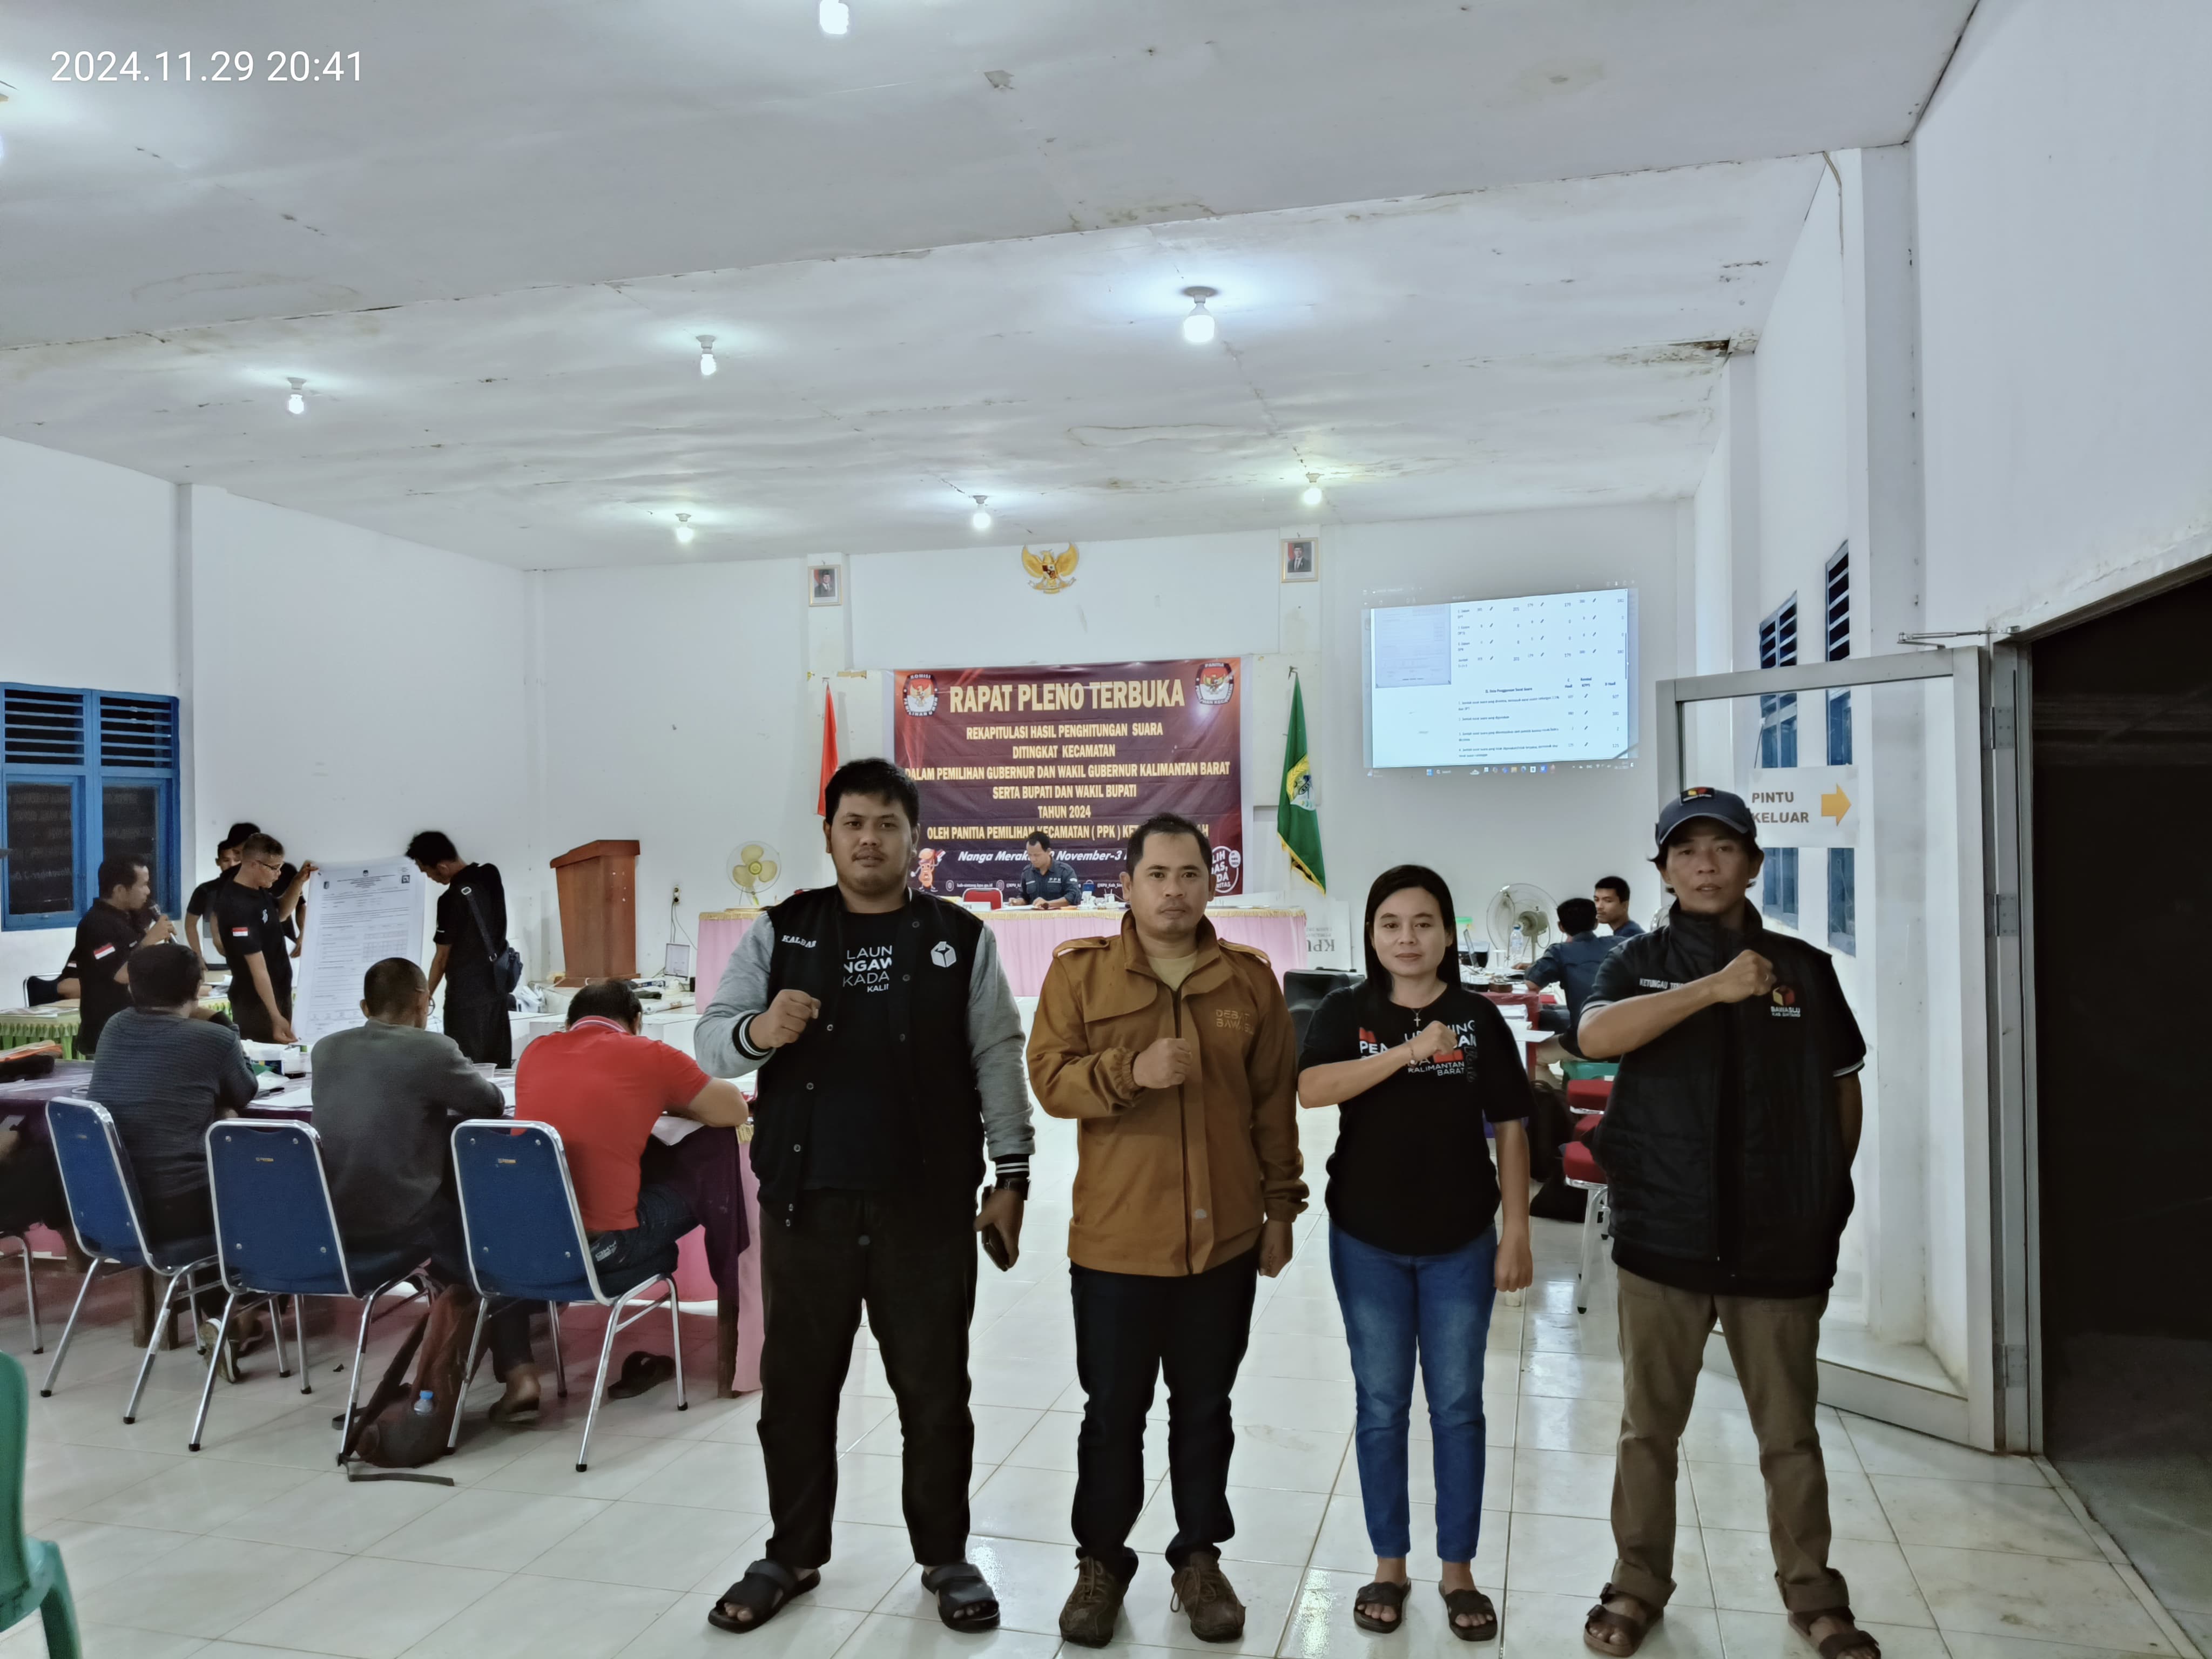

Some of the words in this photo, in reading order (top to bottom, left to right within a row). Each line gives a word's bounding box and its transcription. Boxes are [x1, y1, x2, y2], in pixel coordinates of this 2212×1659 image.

[950, 684, 1013, 713] RAPAT
[1018, 683, 1084, 711] PLENO
[1090, 679, 1185, 709] TERBUKA
[967, 726, 1028, 740] REKAPITULASI
[1030, 725, 1056, 738] HASIL
[1058, 723, 1128, 738] PENGHITUNGAN
[1132, 723, 1163, 736] SUARA
[1013, 745, 1058, 759] DITINGKAT
[1062, 744, 1115, 758] KECAMATAN
[905, 767, 934, 780] DALAM
[937, 766, 984, 780] PEMILIHAN
[987, 766, 1035, 779] GUBERNUR
[1037, 765, 1055, 778] DAN
[1057, 765, 1086, 778] WAKIL
[1088, 764, 1137, 777] GUBERNUR
[1140, 763, 1198, 777] KALIMANTAN
[1200, 761, 1230, 775] BARAT
[993, 786, 1020, 799] SERTA
[1022, 786, 1052, 798] BUPATI
[1055, 785, 1073, 798] DAN
[1075, 785, 1104, 798] WAKIL
[1106, 784, 1137, 797] BUPATI
[1752, 792, 1794, 803] PINTU
[1038, 806, 1067, 819] TAHUN
[1069, 805, 1091, 818] 2024
[1752, 812, 1809, 823] KELUAR
[927, 827, 949, 839] OLEH
[952, 826, 985, 839] PANITIA
[987, 826, 1035, 838] PEMILIHAN
[1097, 825, 1115, 838] PPK
[958, 851, 992, 864] Nanga
[995, 849, 1030, 861] Merak
[1056, 849, 1122, 861] November-3
[1212, 850, 1225, 864] LIH
[1217, 872, 1229, 882] DA
[842, 971, 889, 987] KADA
[1437, 1068, 1465, 1076] BARAT
